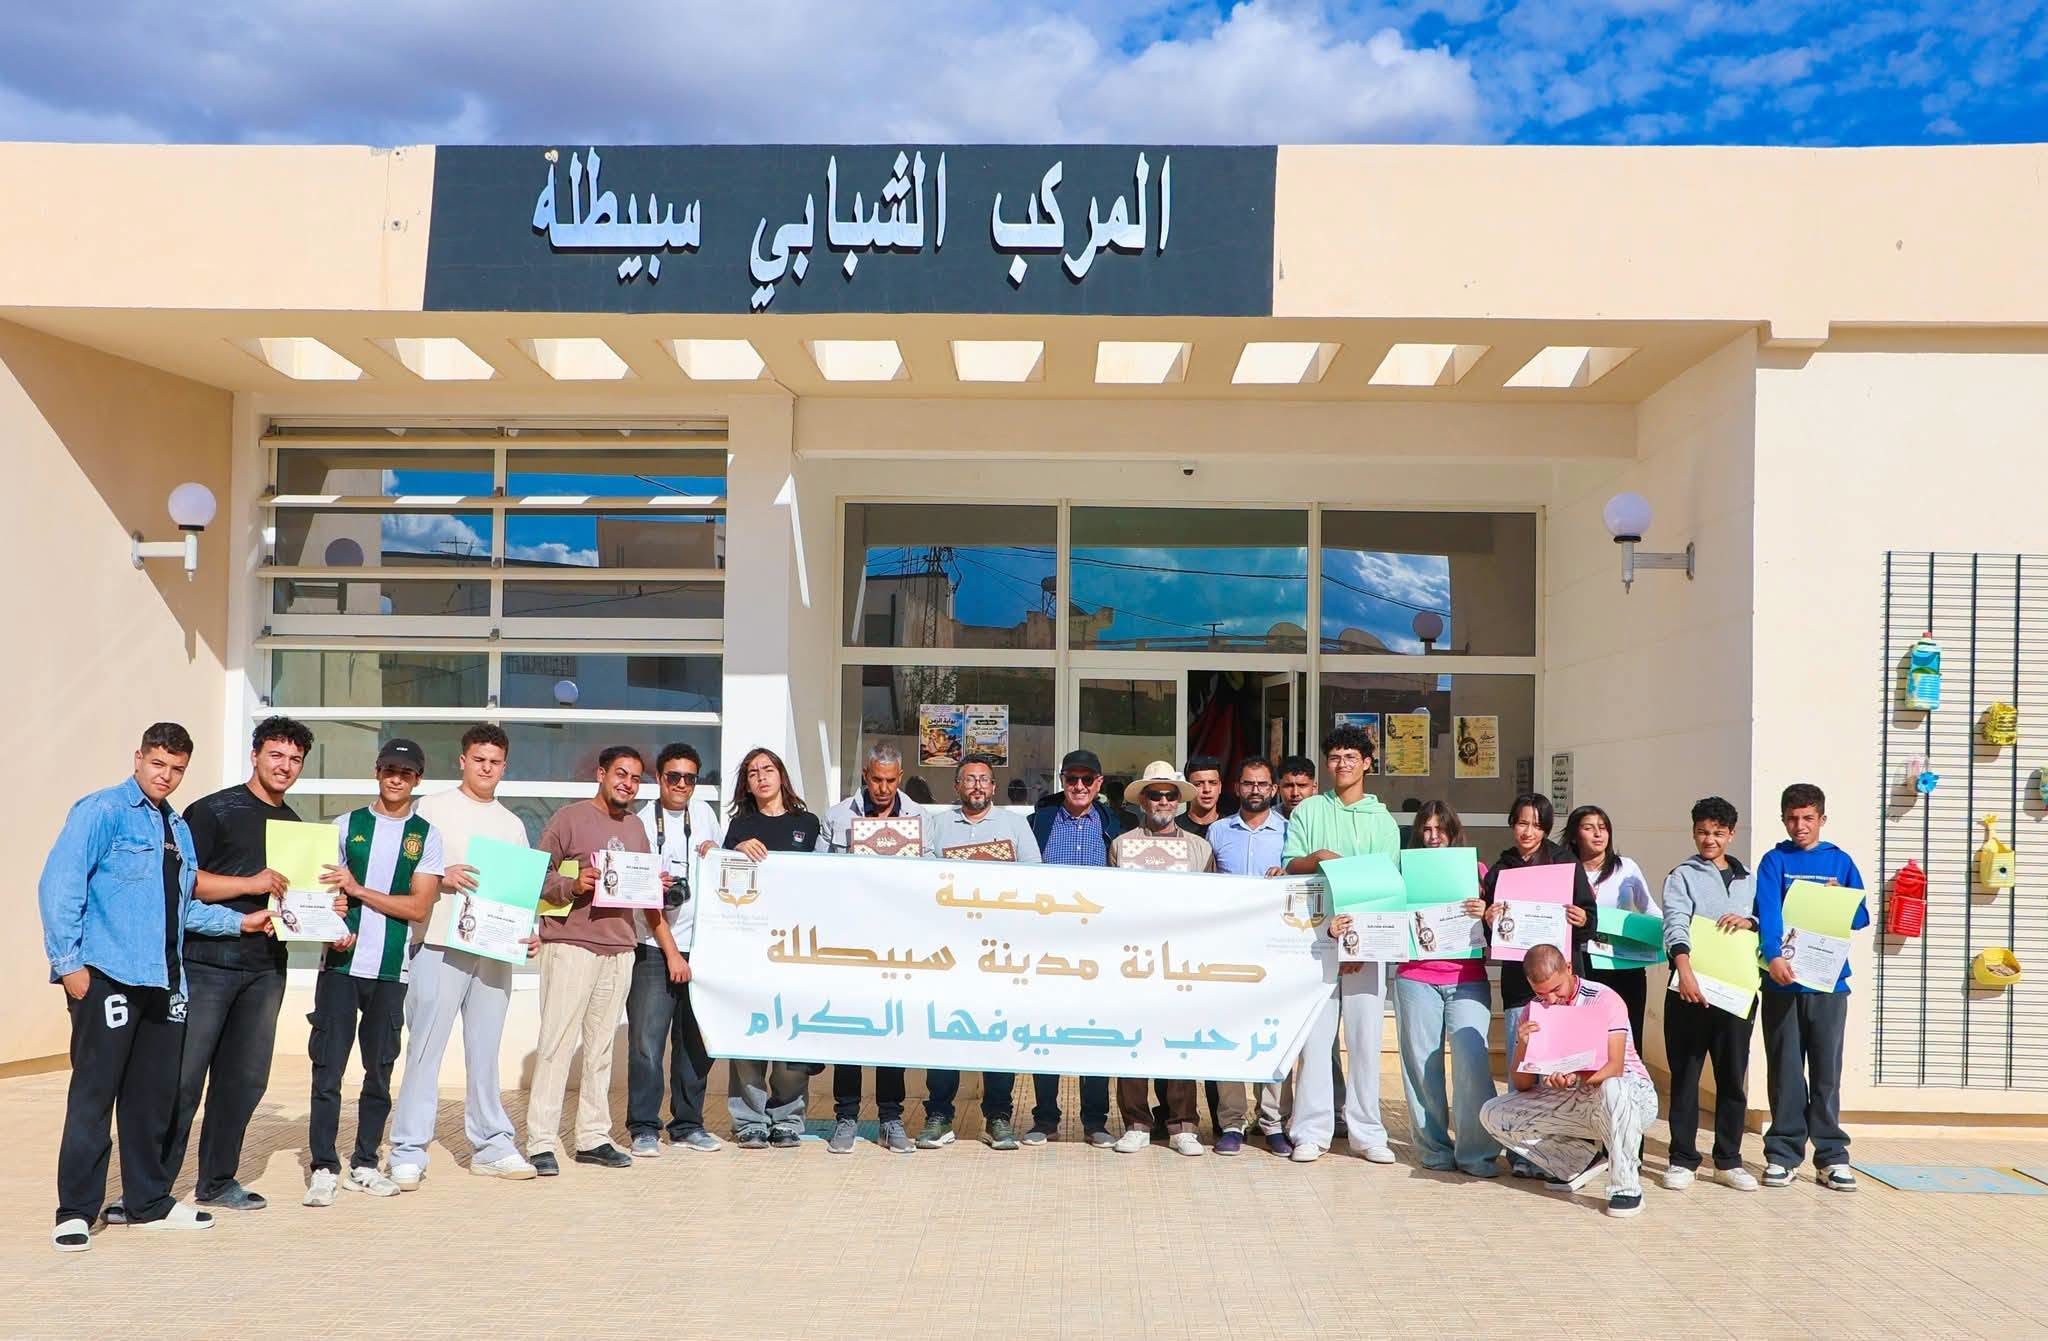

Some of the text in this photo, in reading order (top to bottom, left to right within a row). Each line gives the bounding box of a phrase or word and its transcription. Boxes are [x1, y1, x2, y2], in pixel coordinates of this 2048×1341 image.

[750, 150, 947, 309] الشبابي
[993, 152, 1171, 284] المركب
[936, 872, 1105, 925] جمعية
[767, 923, 1267, 992] صيانة مدينة سبيطلة
[104, 993, 129, 1029] 6
[744, 992, 1280, 1062] ترحب بضيوفها الكرام
